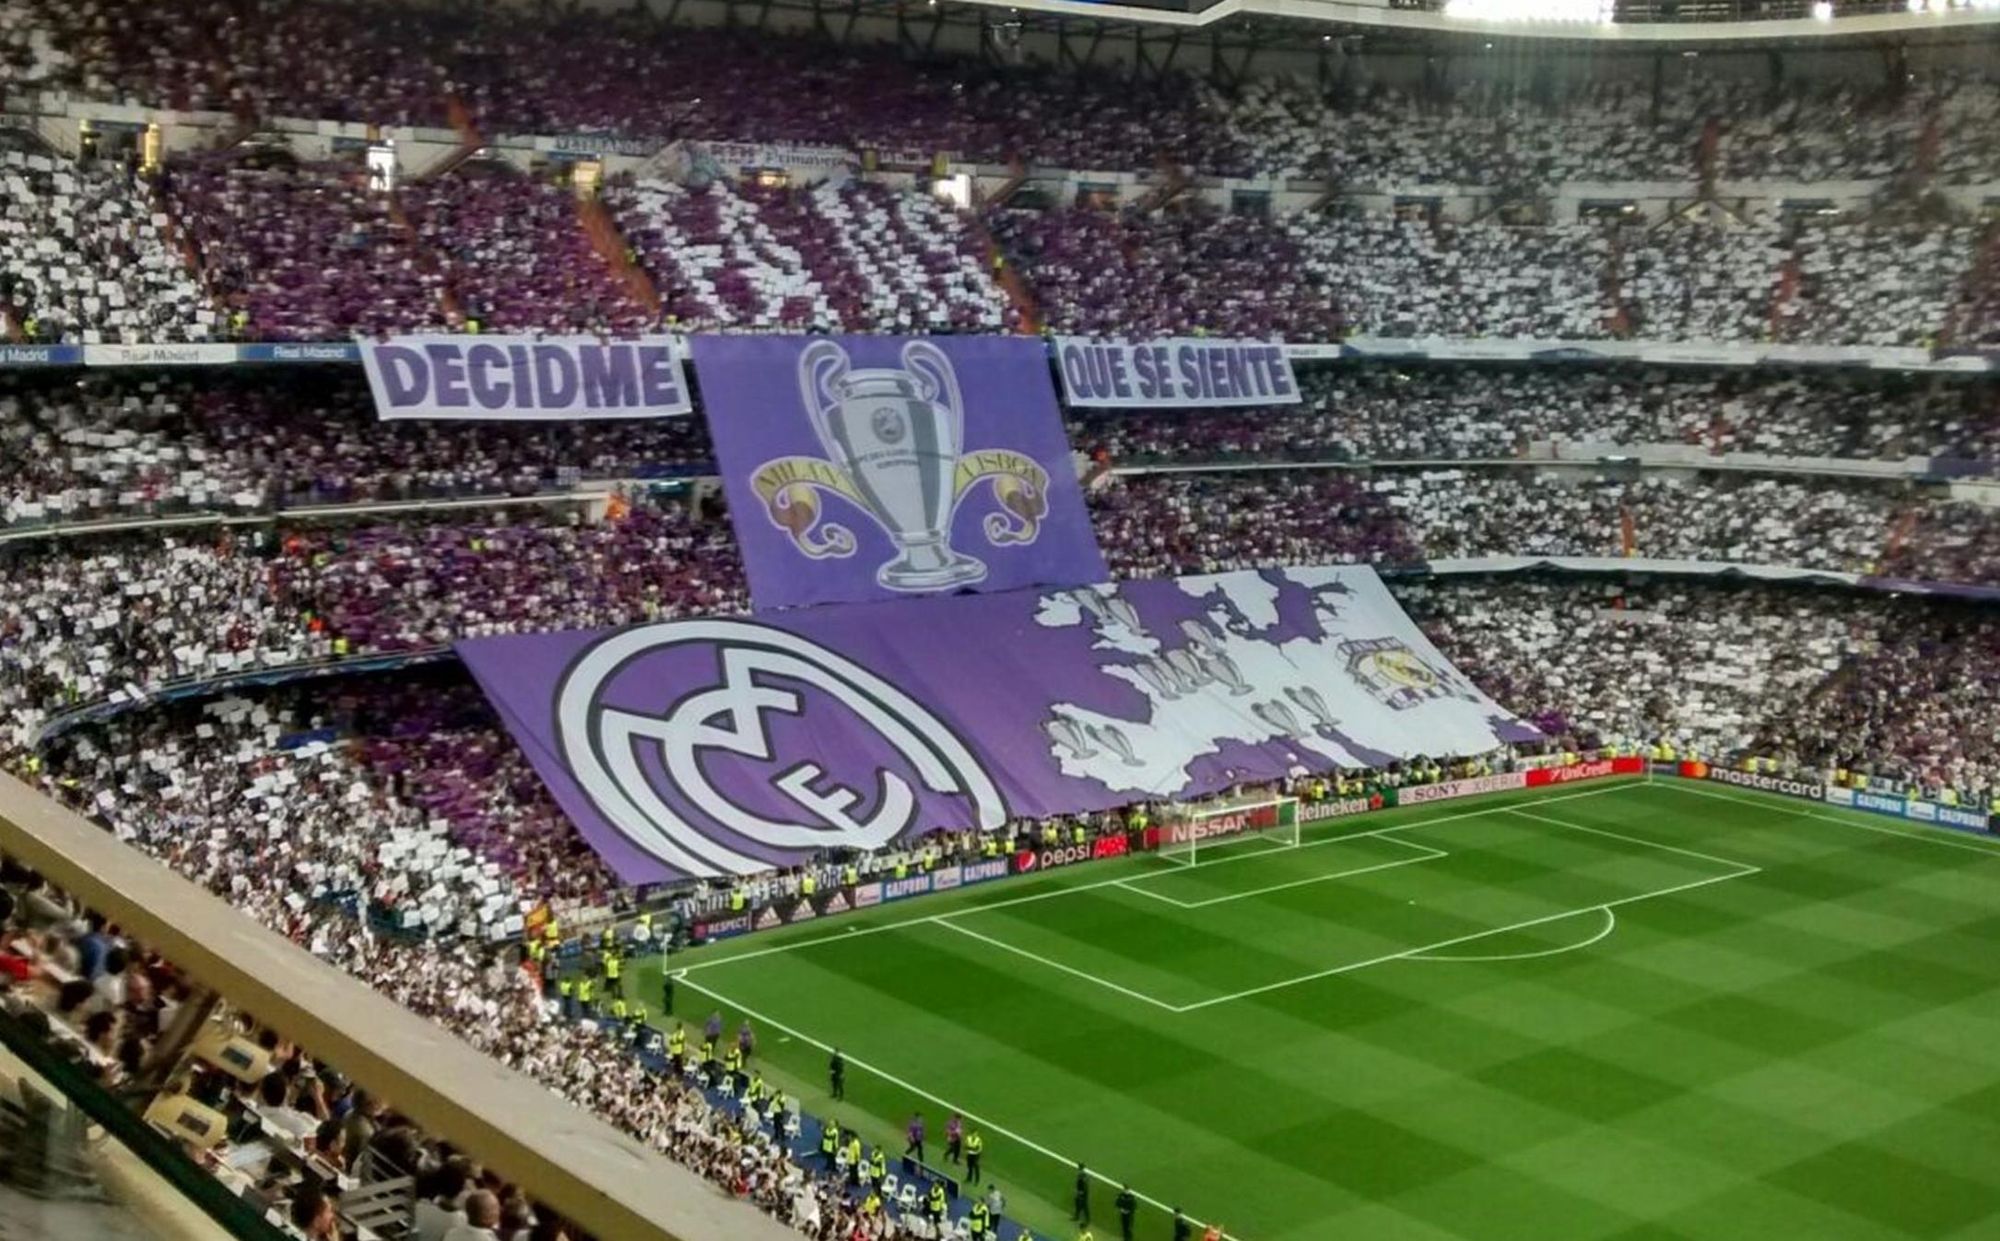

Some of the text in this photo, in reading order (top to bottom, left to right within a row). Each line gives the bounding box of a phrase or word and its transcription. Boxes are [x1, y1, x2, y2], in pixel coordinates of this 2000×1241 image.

[373, 343, 680, 409] DECIDME
[1063, 344, 1292, 399] QUE SE SIENTE
[1414, 774, 1524, 800] SONY XPERIA
[1711, 765, 1822, 798] mastercard
[1295, 798, 1369, 821] Heineken
[1172, 813, 1250, 843] NISSAN
[1041, 844, 1090, 869] pepsi
[708, 917, 748, 934] RESPECT
